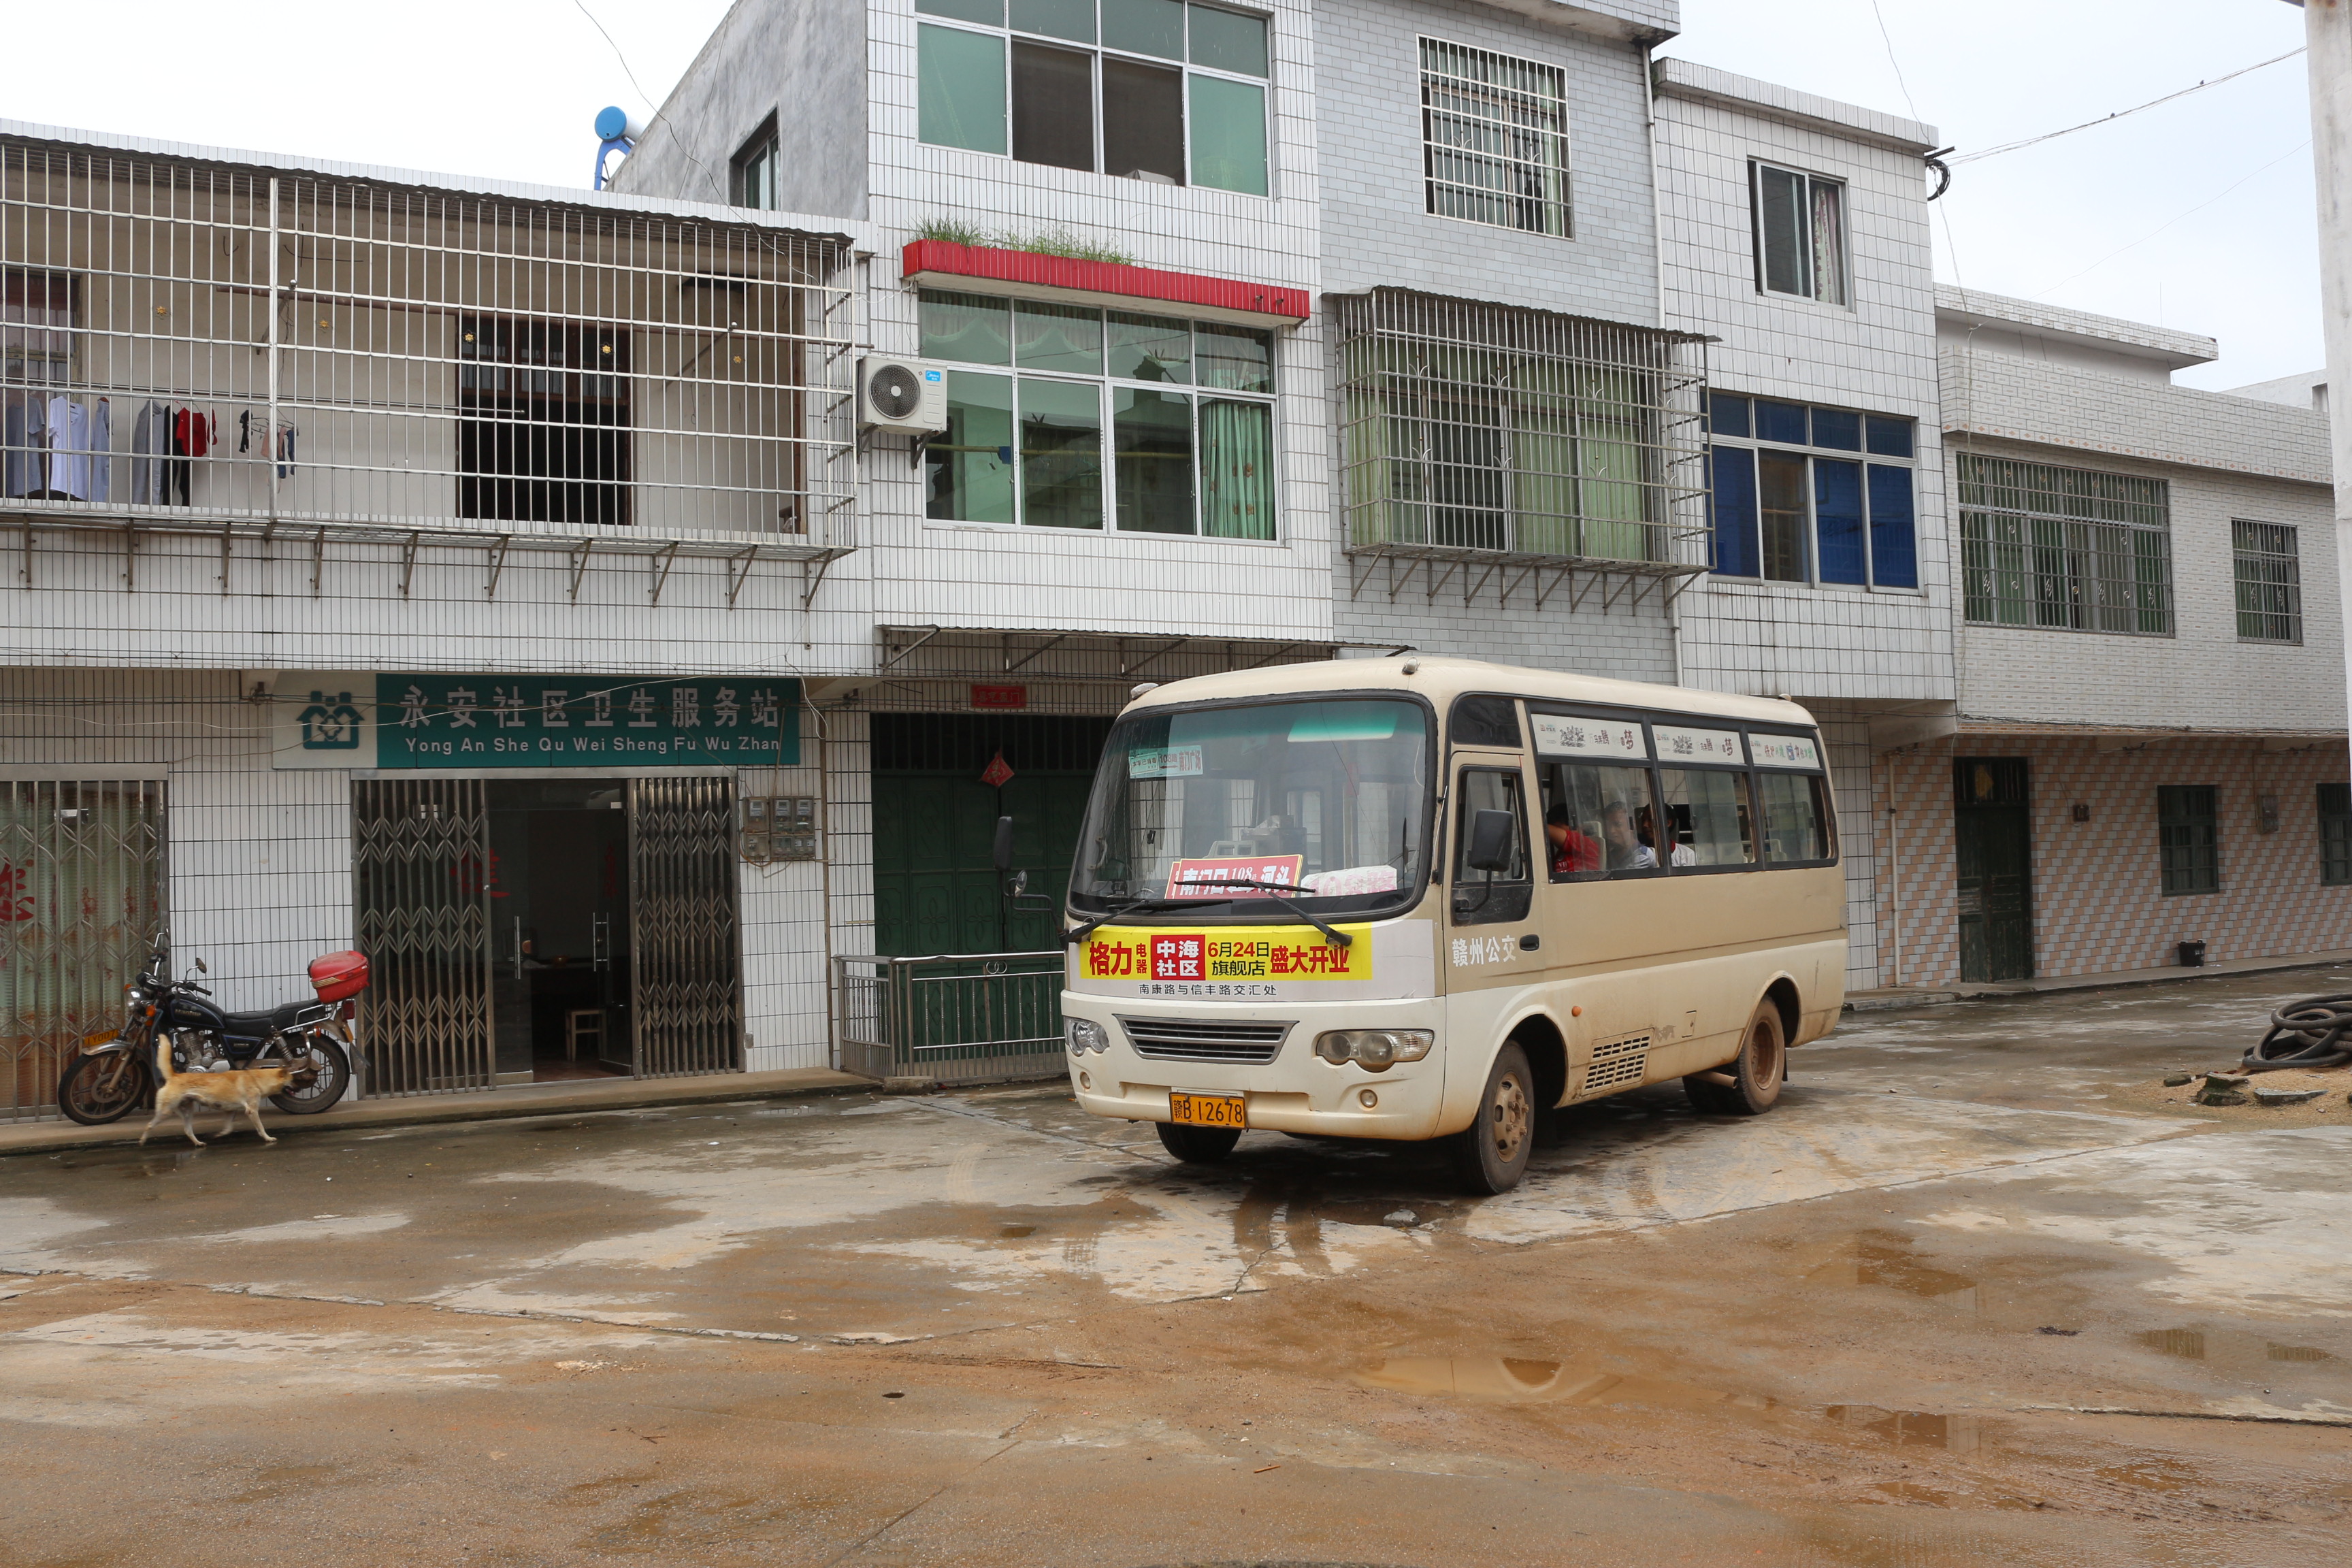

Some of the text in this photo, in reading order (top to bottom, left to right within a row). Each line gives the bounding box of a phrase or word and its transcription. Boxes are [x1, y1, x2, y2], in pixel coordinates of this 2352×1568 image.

[399, 685, 779, 728] 永安社区卫生服务站
[406, 736, 779, 755] Yong An She Qu Wei Sheng Fu Wu Zhan
[1089, 941, 1132, 976] 格力
[1136, 943, 1147, 974] 电器
[1157, 940, 1200, 958] 中海
[1208, 942, 1269, 958] 6月24日
[1452, 934, 1516, 967] 赣州公交
[1157, 960, 1200, 977] 社区
[1212, 960, 1265, 976] 旗舰店
[1271, 945, 1350, 974] 盛大开业
[1139, 984, 1277, 996] 南康路与信丰路交汇处
